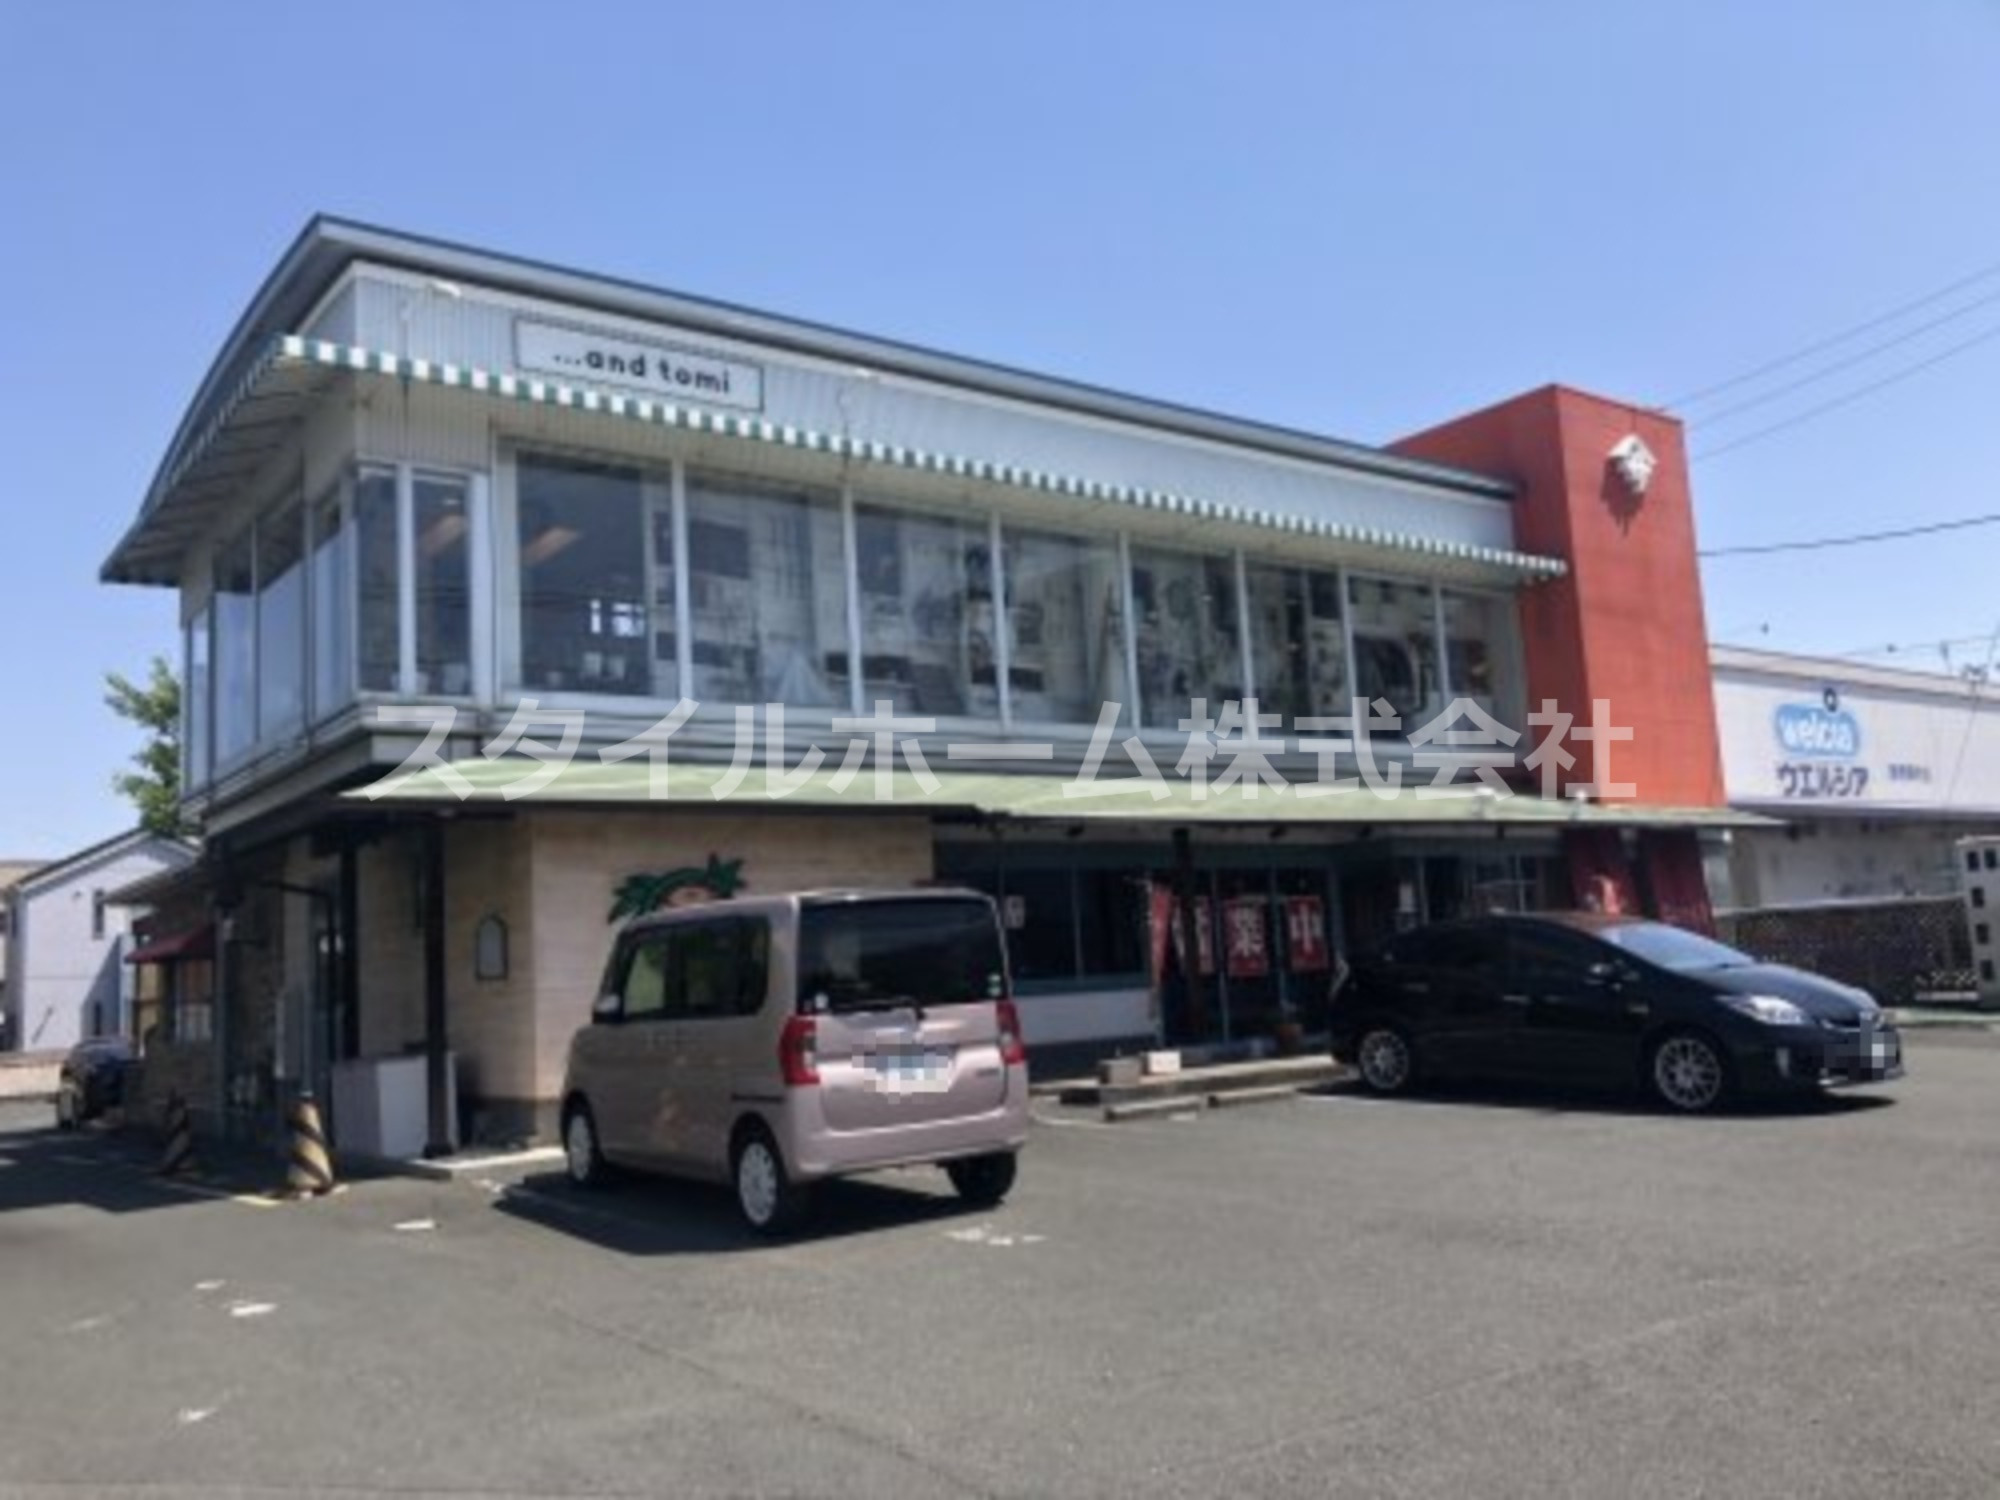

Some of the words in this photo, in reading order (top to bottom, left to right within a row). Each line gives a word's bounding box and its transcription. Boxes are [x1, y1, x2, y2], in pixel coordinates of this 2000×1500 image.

[659, 359, 730, 393] tomi
[1776, 762, 1869, 797] ウエルシア
